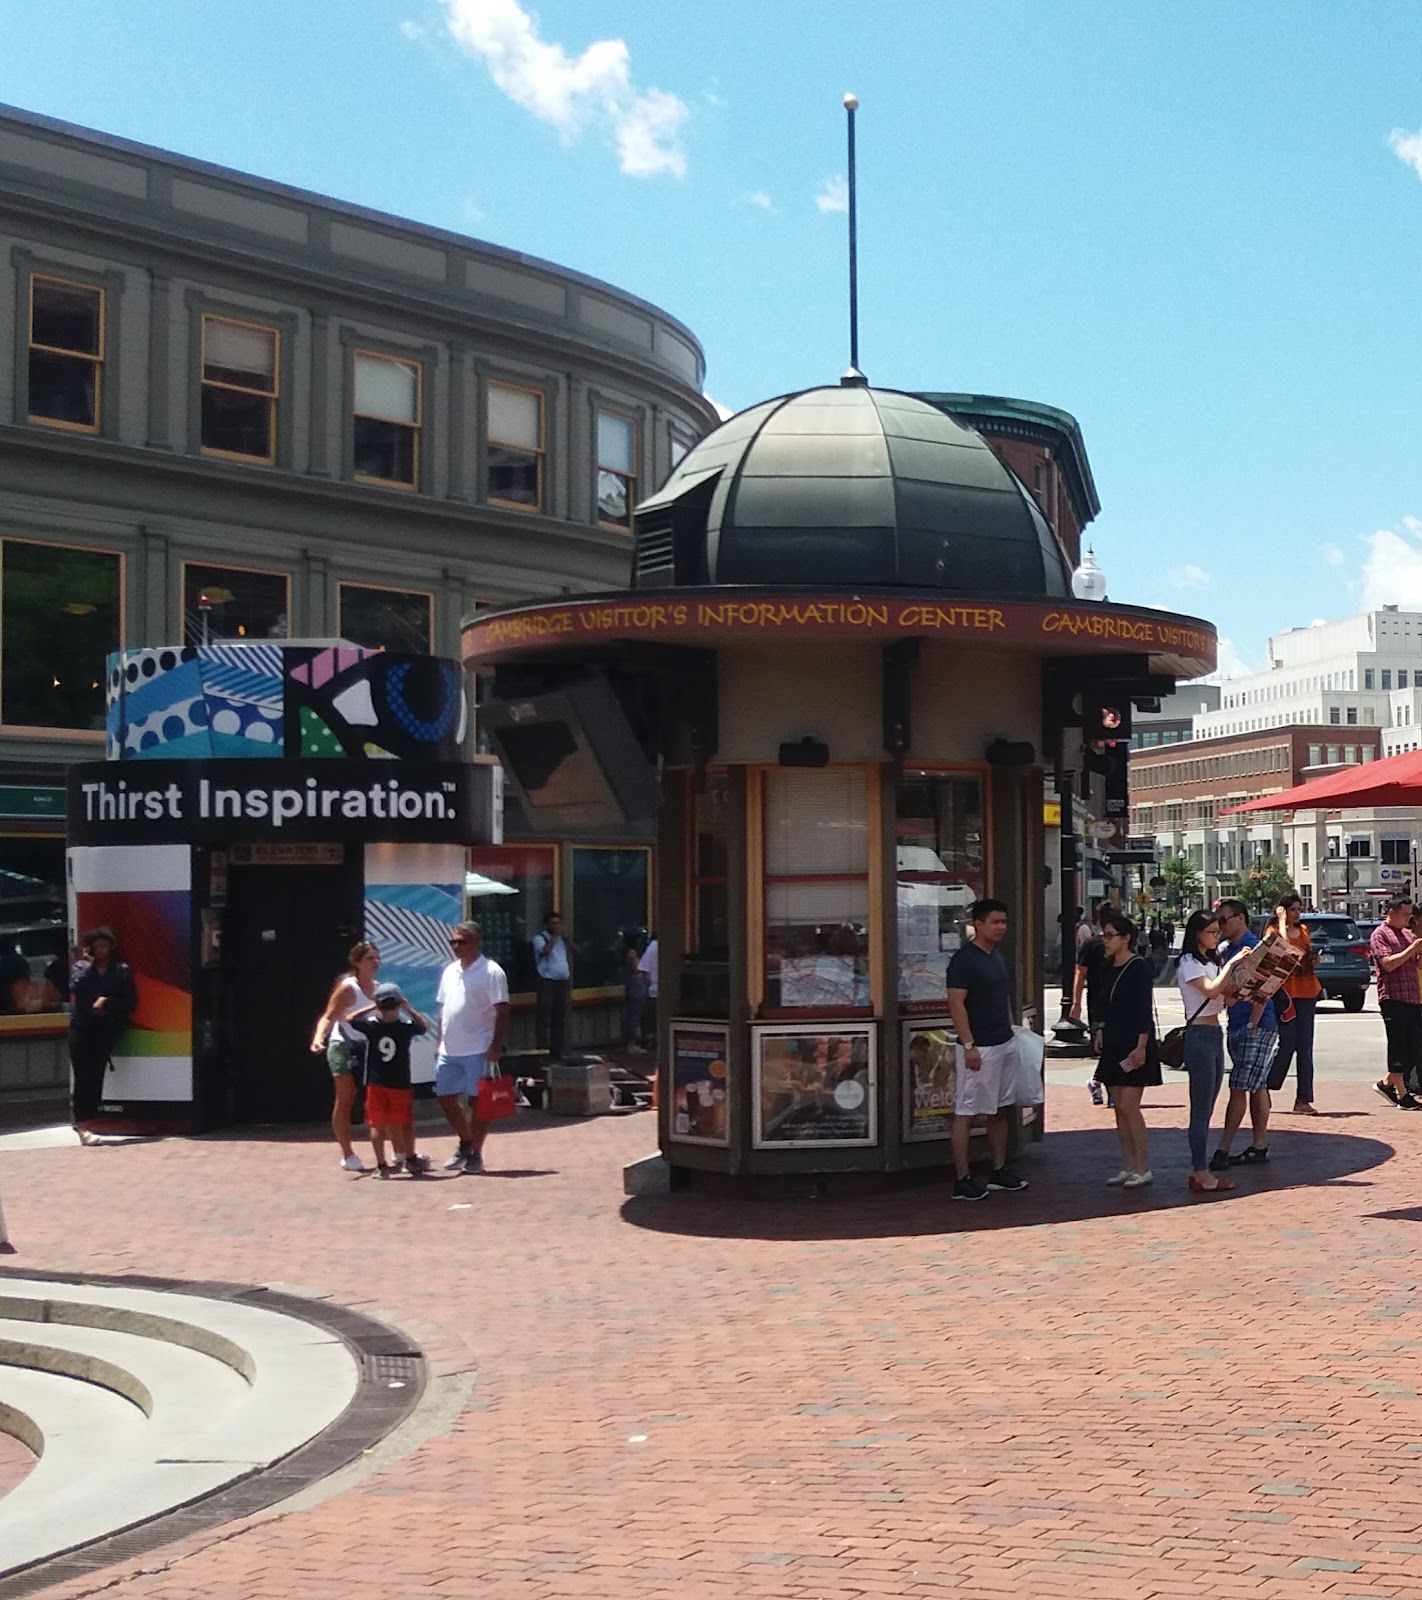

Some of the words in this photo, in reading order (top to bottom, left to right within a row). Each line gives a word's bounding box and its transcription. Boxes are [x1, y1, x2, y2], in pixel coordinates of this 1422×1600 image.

[579, 604, 687, 631] VISITOR'S
[697, 602, 888, 627] INFORMATION
[899, 605, 1006, 632] CENTER
[1042, 612, 1153, 642] CAMBRIDGE
[82, 781, 183, 821] Thirst
[379, 1036, 396, 1062] 9
[914, 1088, 954, 1107] Welc
